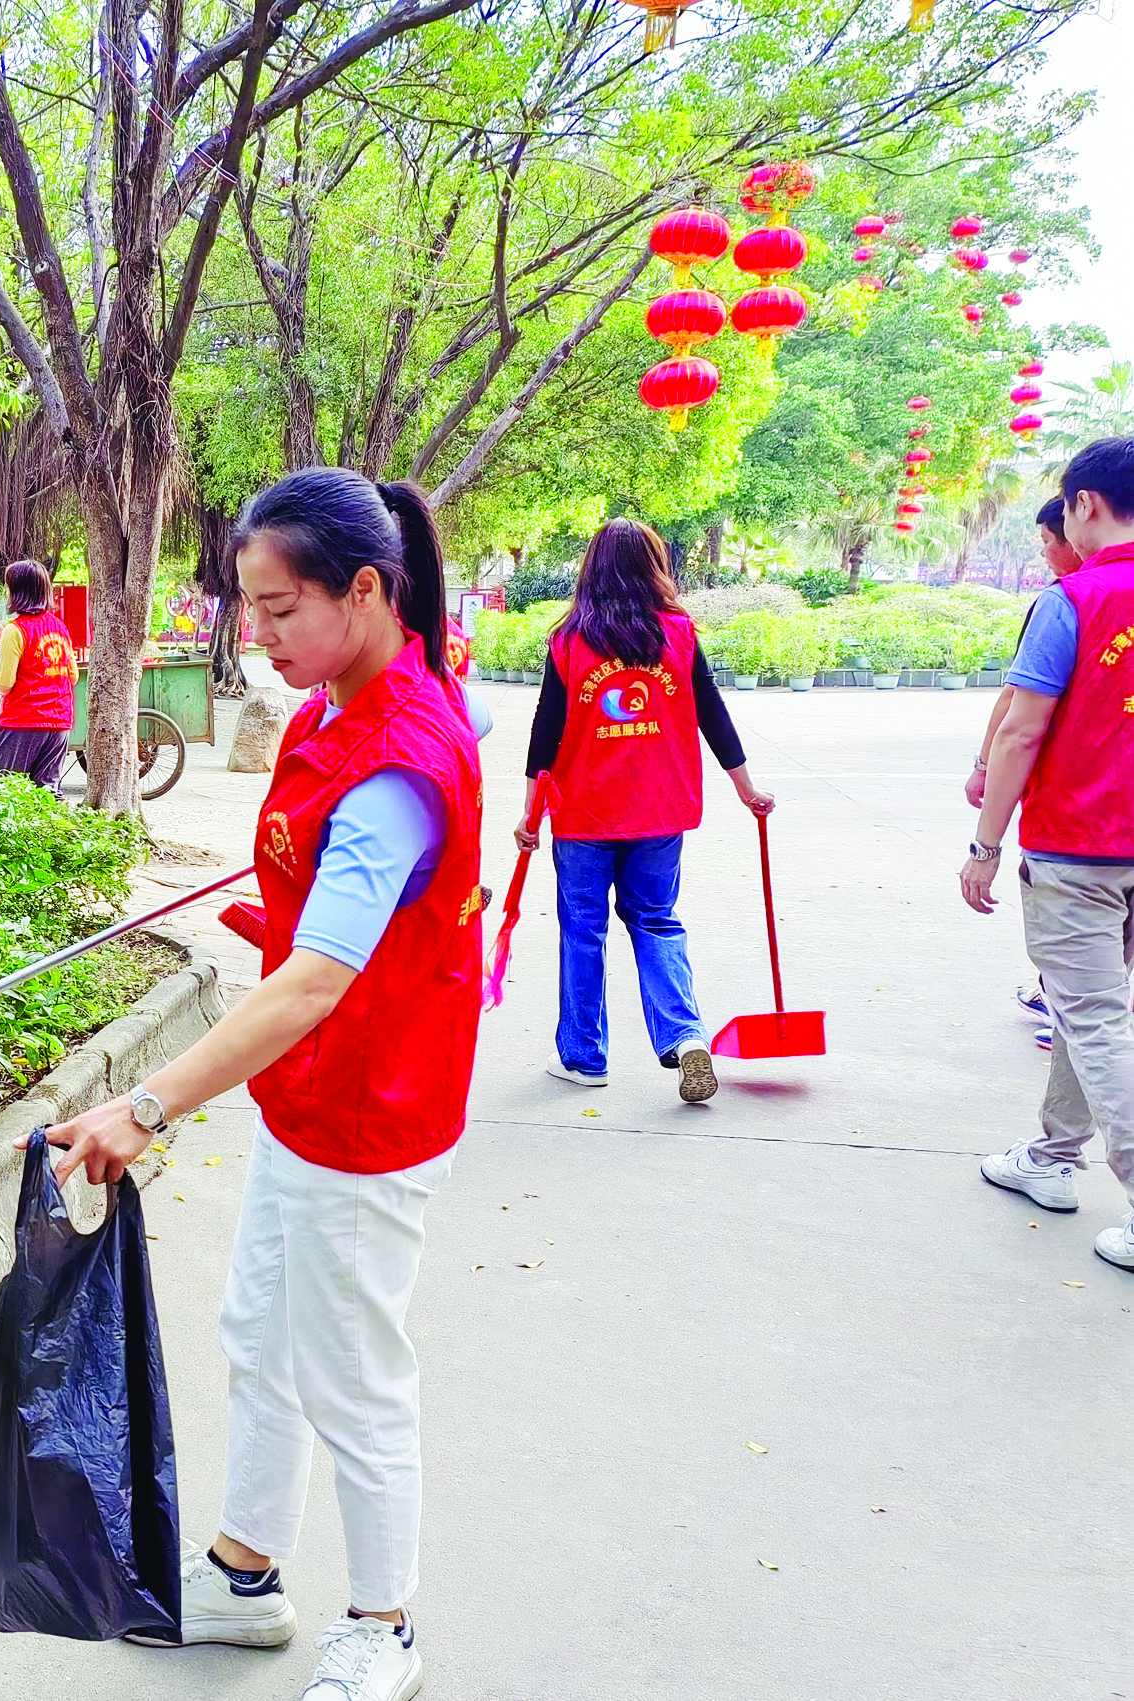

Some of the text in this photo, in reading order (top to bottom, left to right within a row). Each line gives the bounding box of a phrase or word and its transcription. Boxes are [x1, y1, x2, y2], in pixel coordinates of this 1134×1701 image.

[579, 657, 678, 703] 石湾社区党务中心
[596, 721, 661, 738] 志愿服务队
